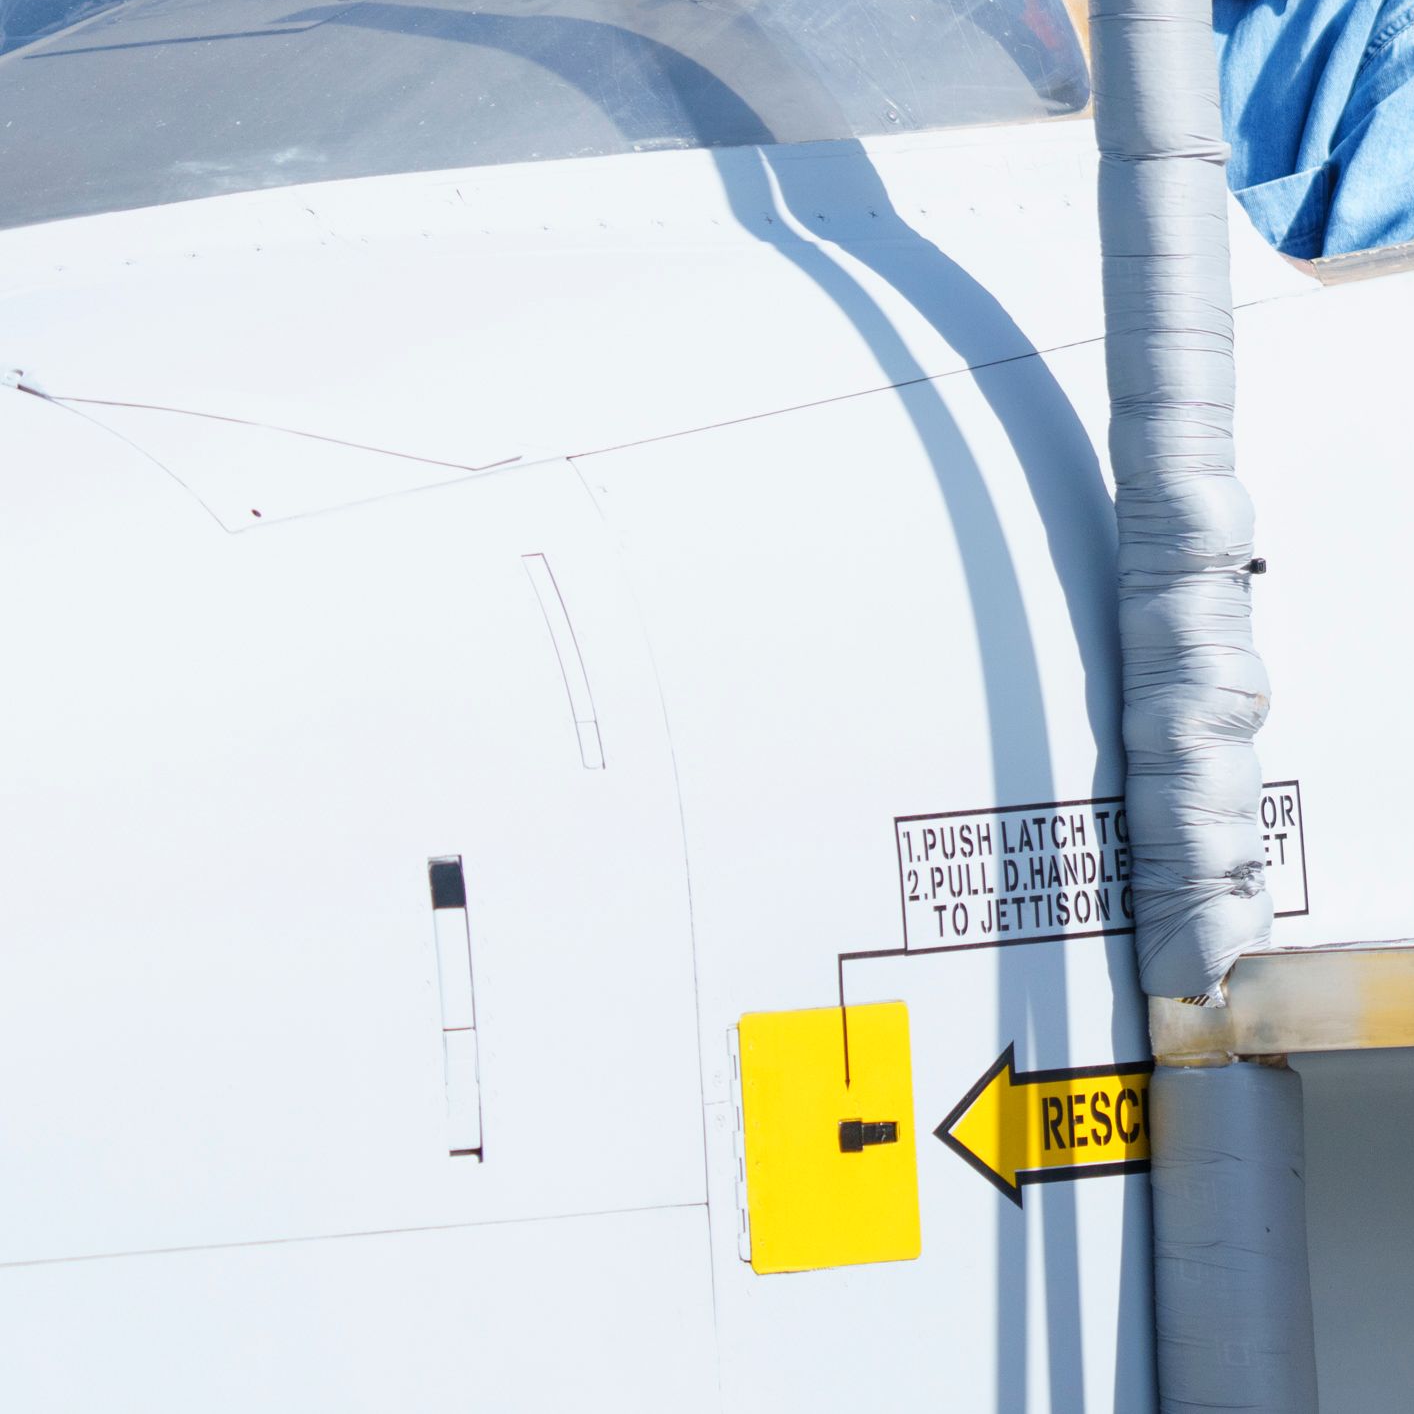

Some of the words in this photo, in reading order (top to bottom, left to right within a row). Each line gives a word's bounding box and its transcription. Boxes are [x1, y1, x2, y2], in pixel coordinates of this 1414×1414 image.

[903, 823, 993, 863] 1.PUSH
[1002, 815, 1086, 855] LATCH
[1096, 809, 1130, 844] TO
[908, 862, 994, 902] 2.PULL
[1003, 848, 1131, 893] D.HANDLE
[933, 902, 969, 938] TO
[981, 888, 1111, 934] JETTISON
